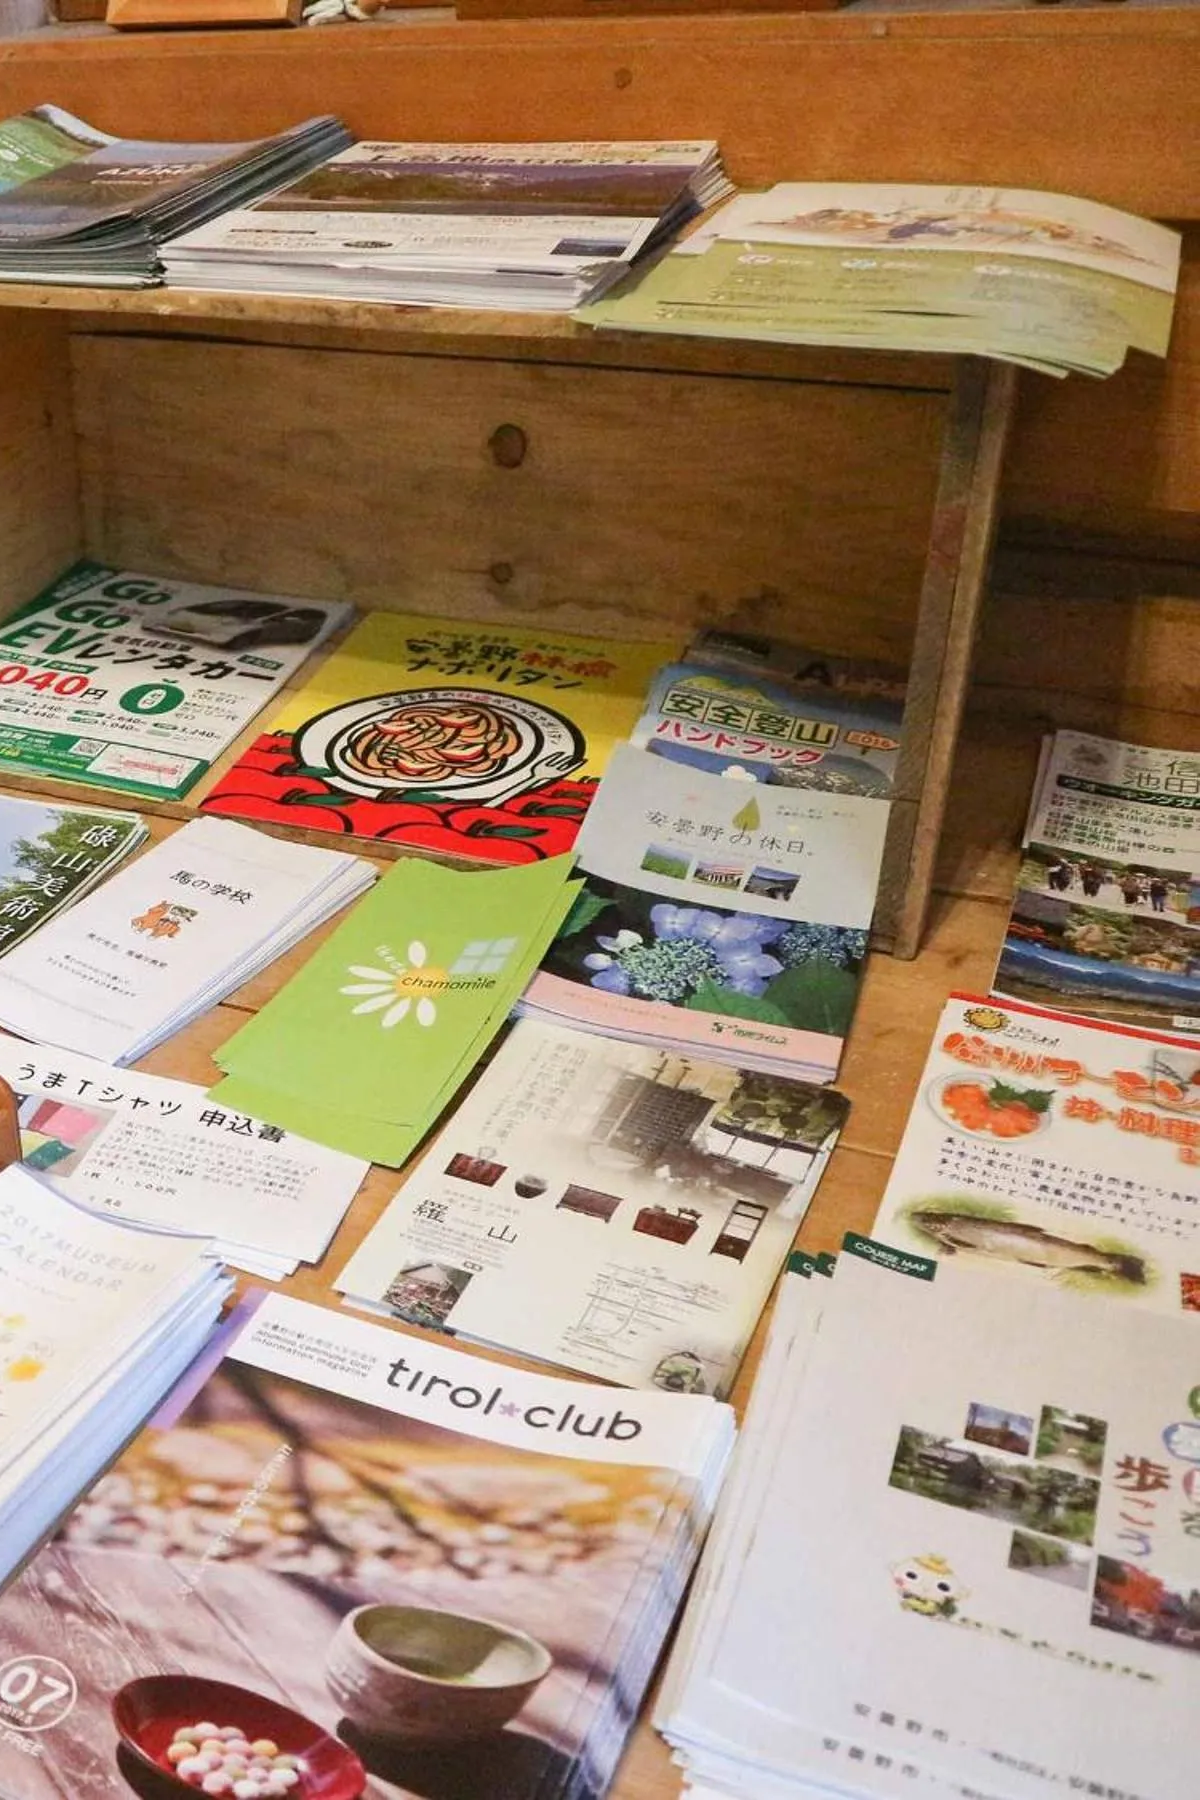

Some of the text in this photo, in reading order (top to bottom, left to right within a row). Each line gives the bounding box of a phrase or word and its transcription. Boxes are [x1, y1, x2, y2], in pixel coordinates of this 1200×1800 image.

[101, 578, 173, 606] Go
[54, 601, 131, 630] Go
[664, 690, 836, 746] 安全登山
[656, 719, 826, 765] ハンドブック
[169, 868, 257, 906] 馬の学校
[400, 975, 498, 991] chamomile
[199, 1107, 289, 1144] 申込書
[854, 1241, 928, 1272] COURSE MAP
[0, 1665, 70, 1716] 07
[0, 1731, 45, 1757] FREE
